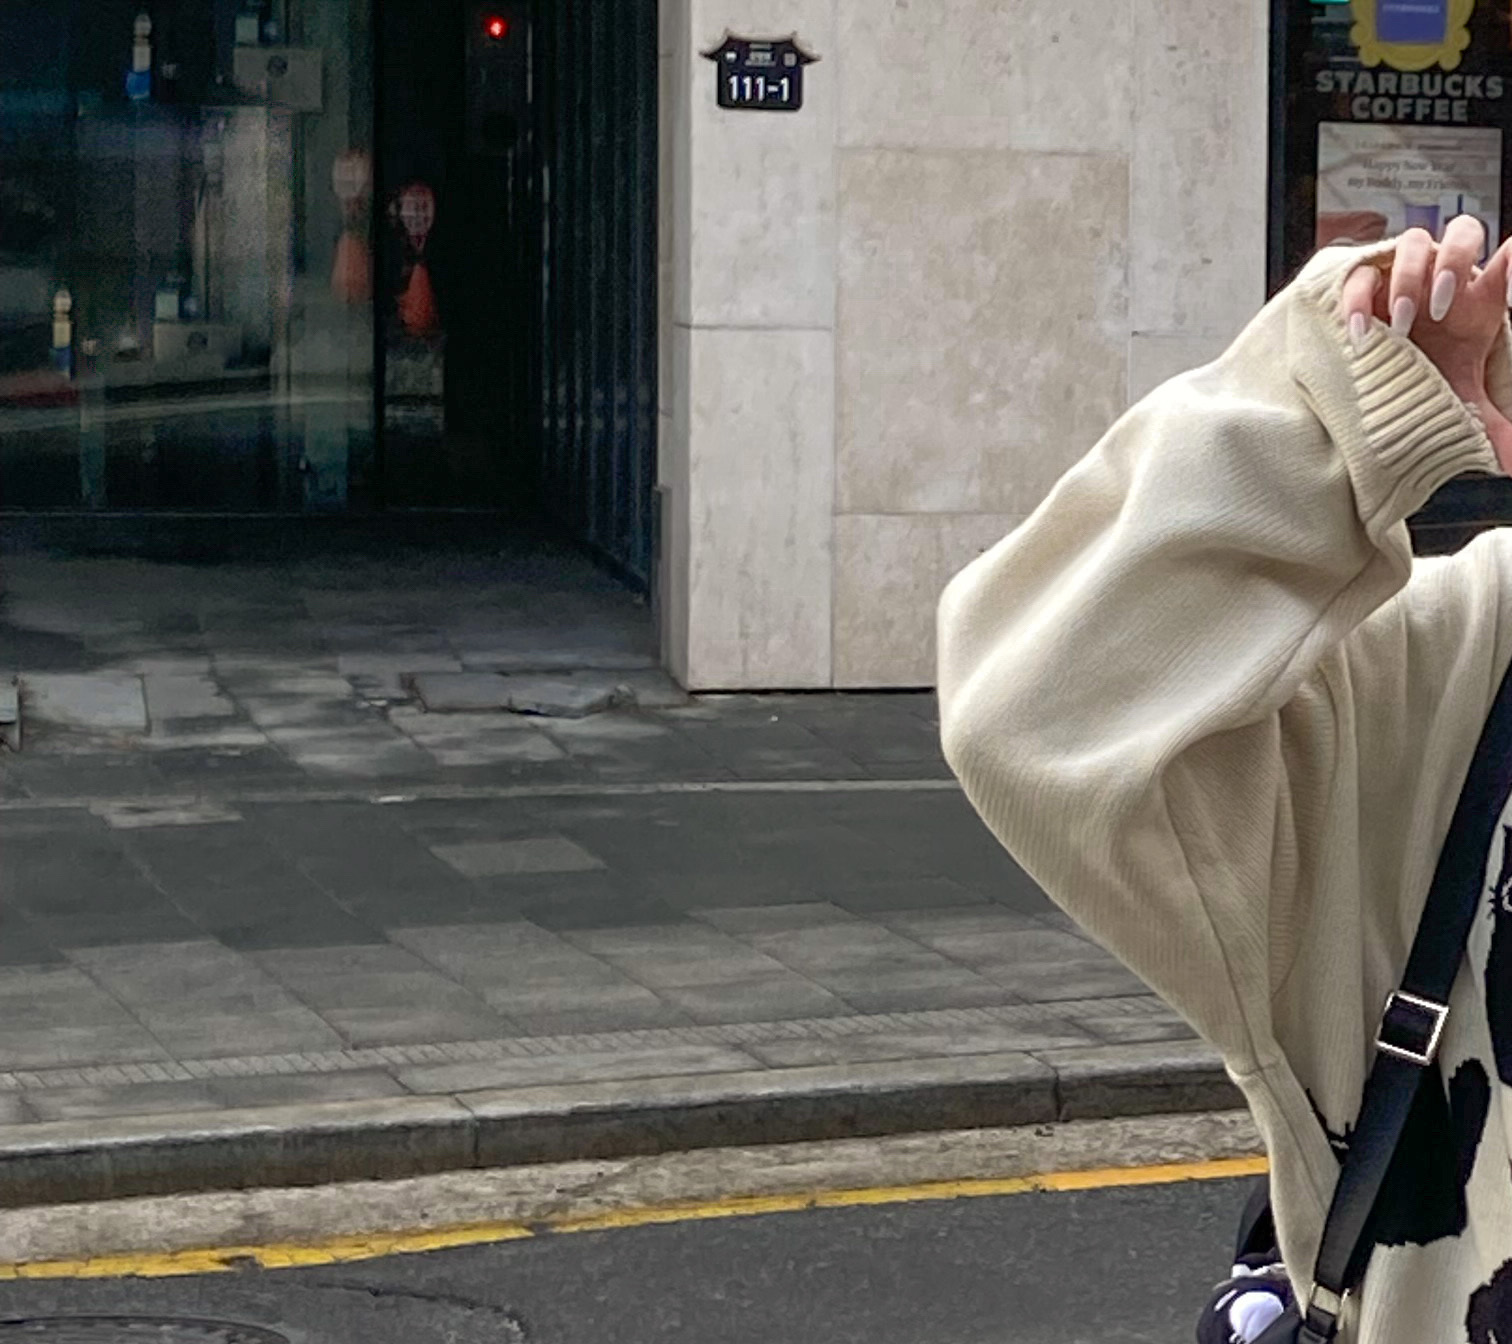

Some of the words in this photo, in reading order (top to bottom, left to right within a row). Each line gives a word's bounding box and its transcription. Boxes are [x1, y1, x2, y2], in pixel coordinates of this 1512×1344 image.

[729, 75, 790, 102] 111-1
[1315, 70, 1504, 99] STARBUCKS
[1352, 96, 1468, 122] COFFEE
